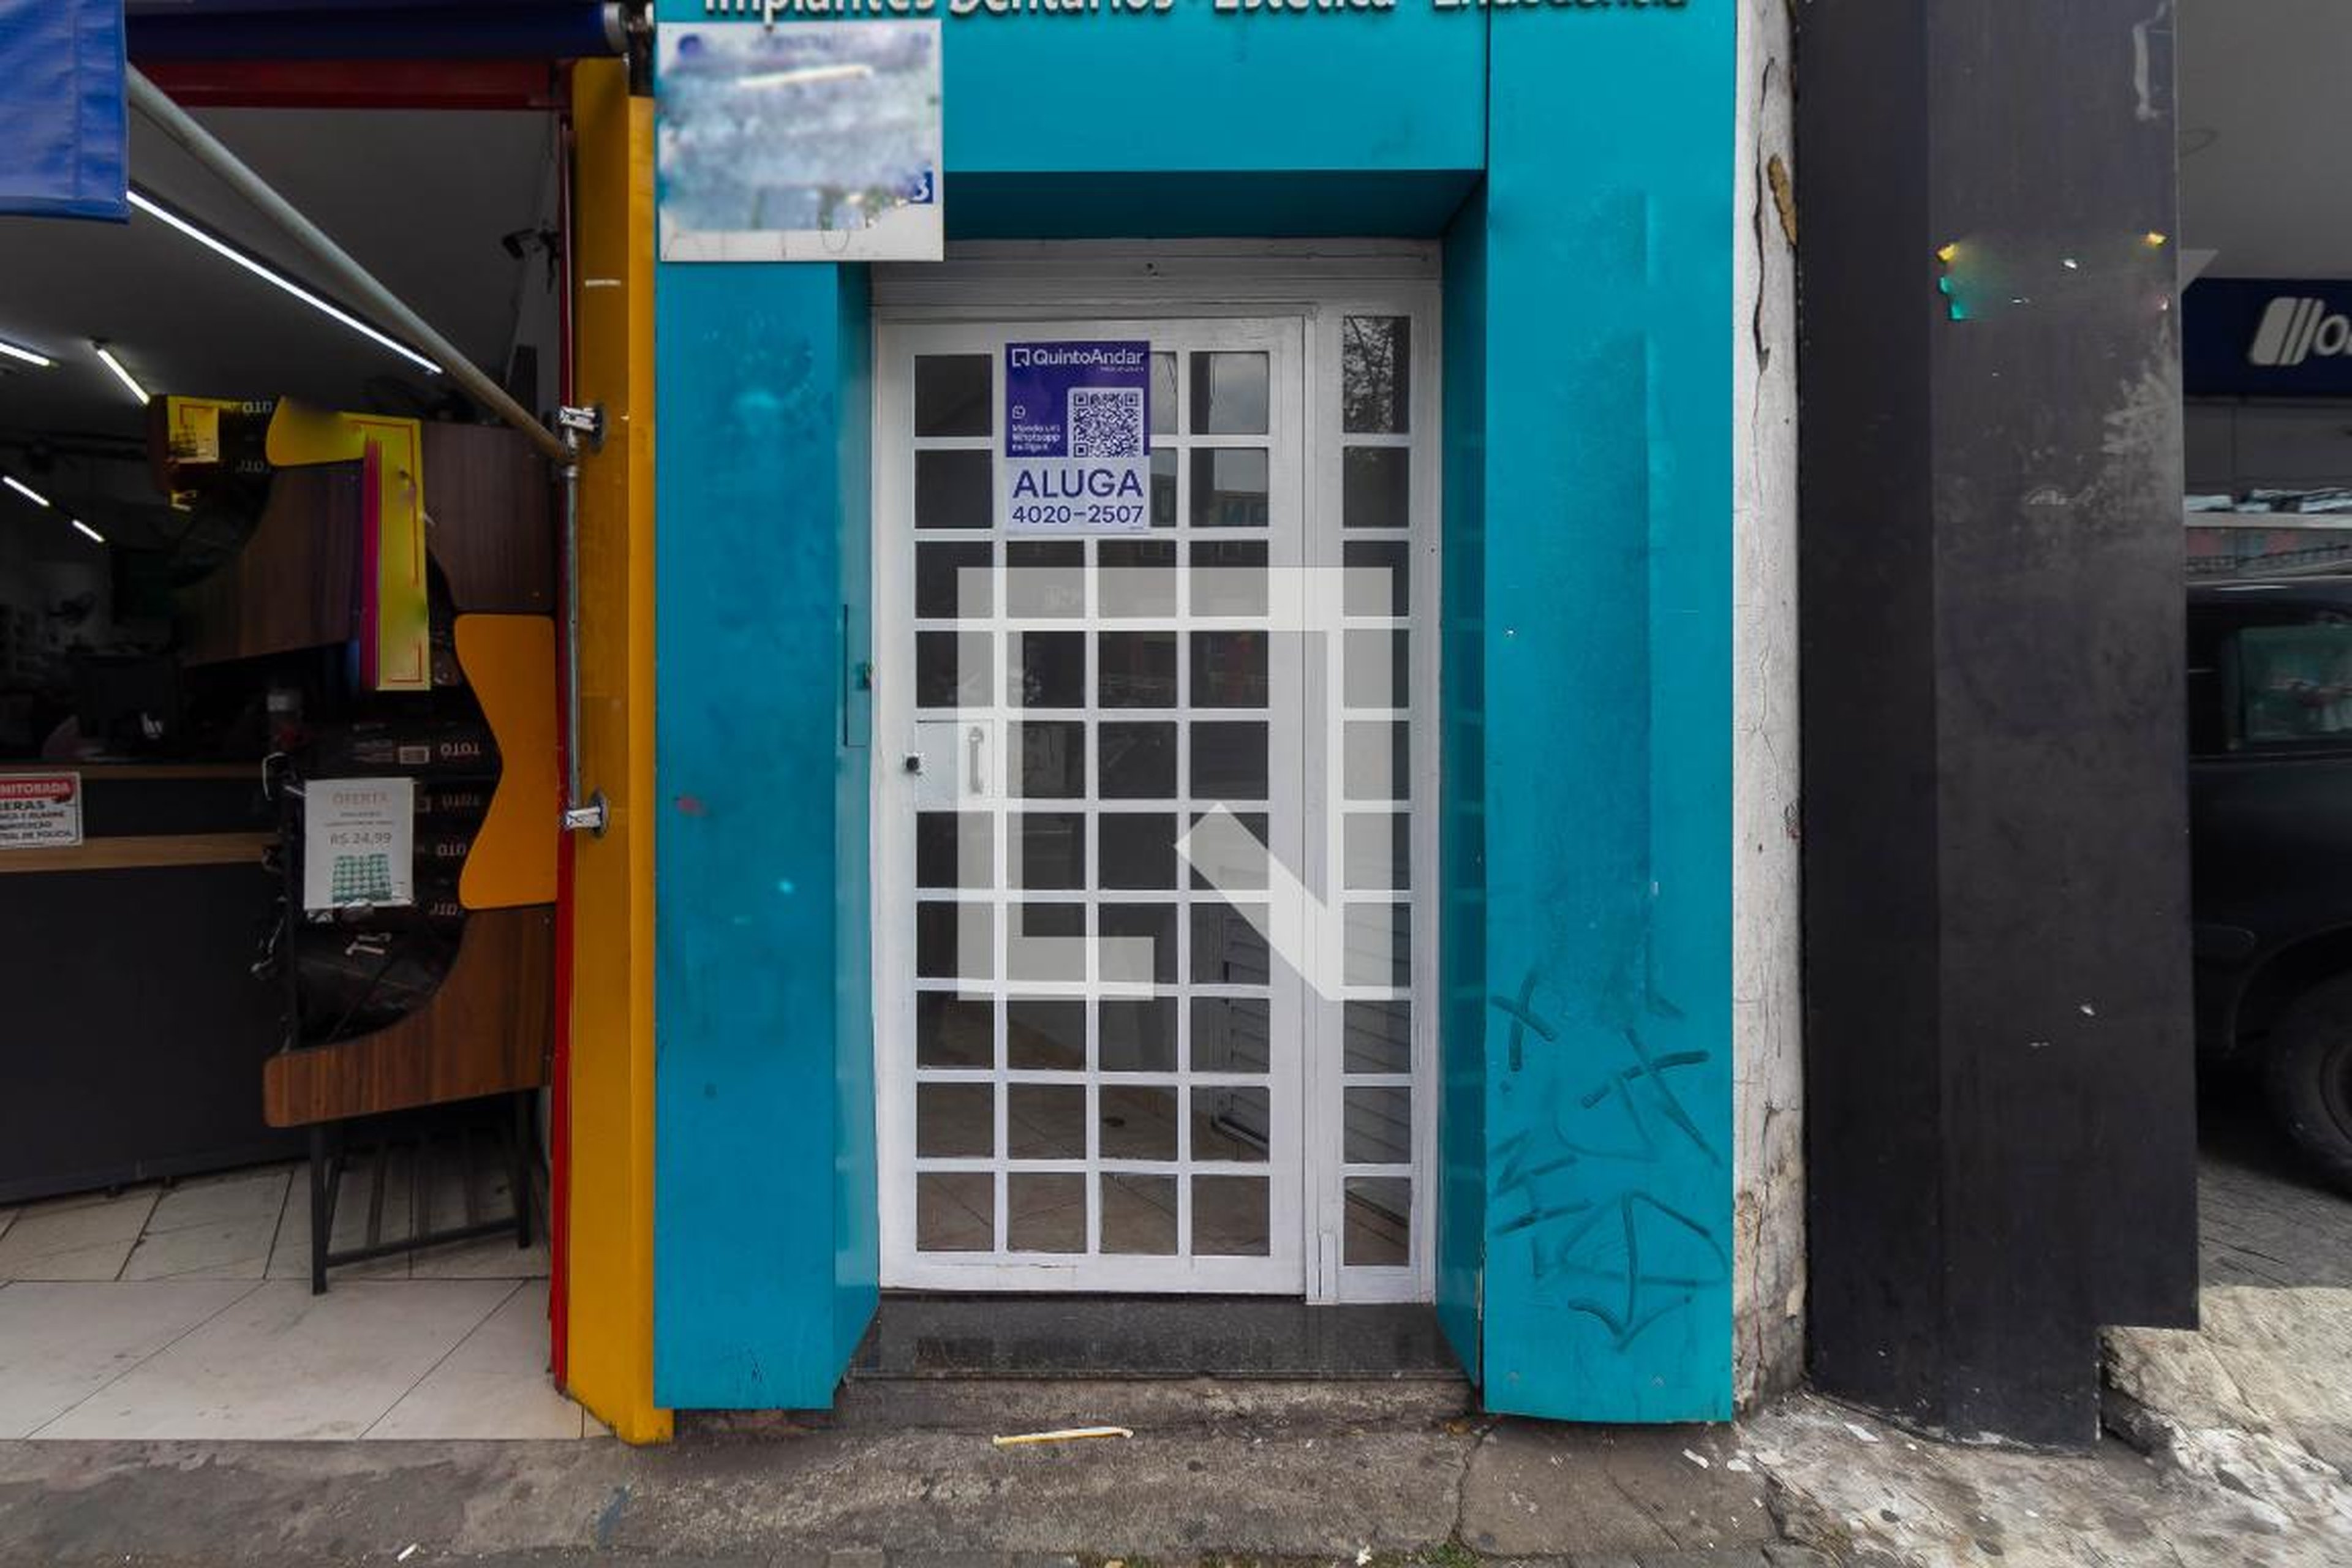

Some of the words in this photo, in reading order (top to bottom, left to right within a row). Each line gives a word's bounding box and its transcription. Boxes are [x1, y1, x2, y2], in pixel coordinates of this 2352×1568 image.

[1033, 349, 1144, 365] QuintoAndar
[1012, 469, 1144, 499] ALUGA
[1012, 505, 1144, 524] 4020-2507
